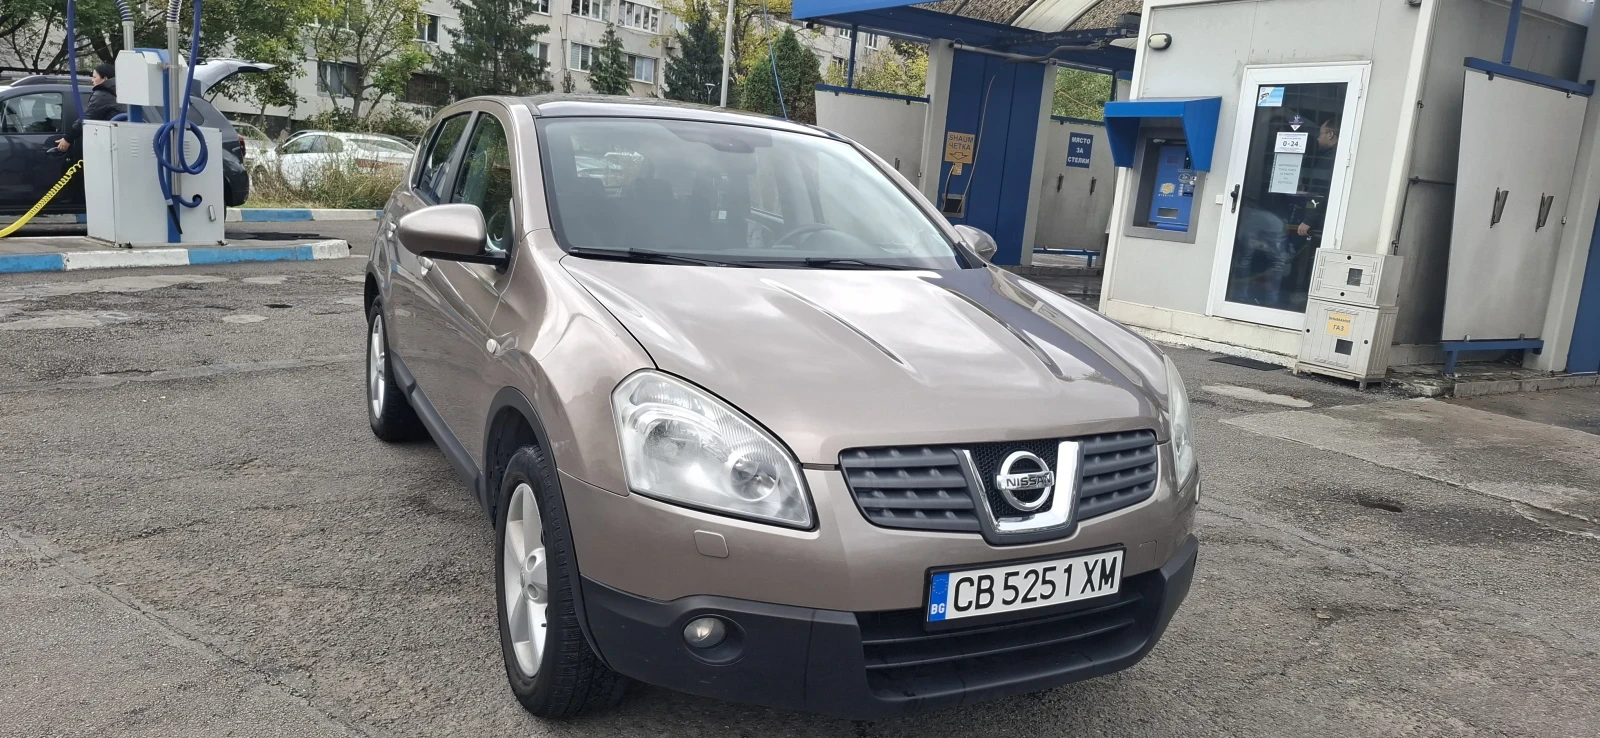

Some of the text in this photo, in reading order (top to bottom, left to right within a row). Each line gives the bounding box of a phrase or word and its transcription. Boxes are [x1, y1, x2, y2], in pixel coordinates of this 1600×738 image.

[949, 134, 973, 143] SHAUM
[1071, 136, 1091, 145] МЯСТО
[949, 142, 971, 151] ЧЕТКА
[1067, 156, 1090, 164] СТЕЛКИ
[1332, 324, 1345, 332] ГАЗ
[1006, 474, 1052, 488] NISSAN
[1001, 563, 1074, 606] 5251
[930, 602, 946, 615] BG
